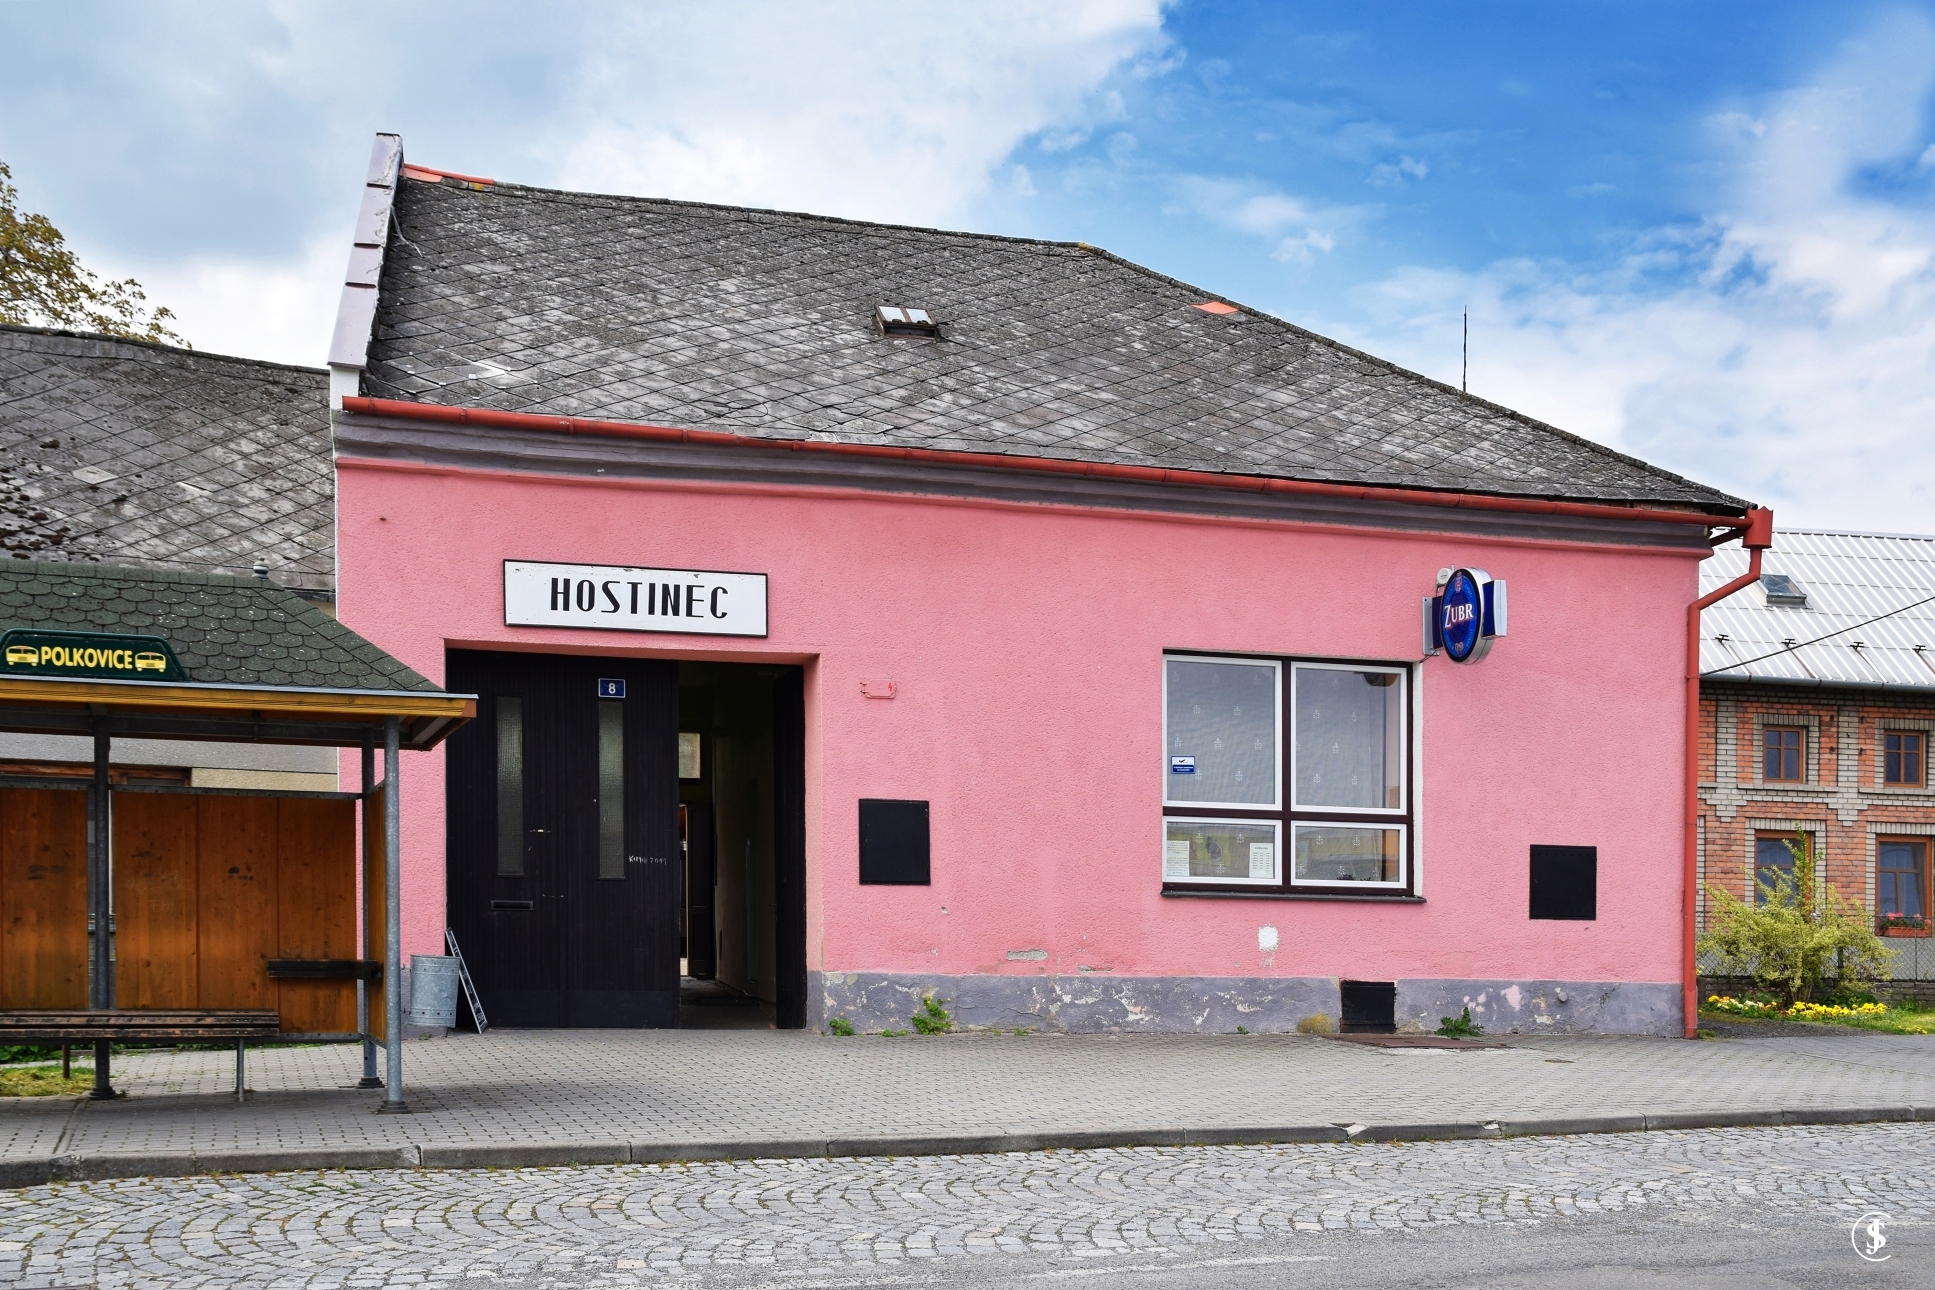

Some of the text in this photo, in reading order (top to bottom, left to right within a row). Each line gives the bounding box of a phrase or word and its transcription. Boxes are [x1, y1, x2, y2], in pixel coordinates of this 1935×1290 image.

[550, 577, 729, 619] HOSTINEC
[1443, 603, 1474, 629] ZUBR
[40, 645, 133, 670] POLKOVICE
[607, 682, 617, 695] 8
